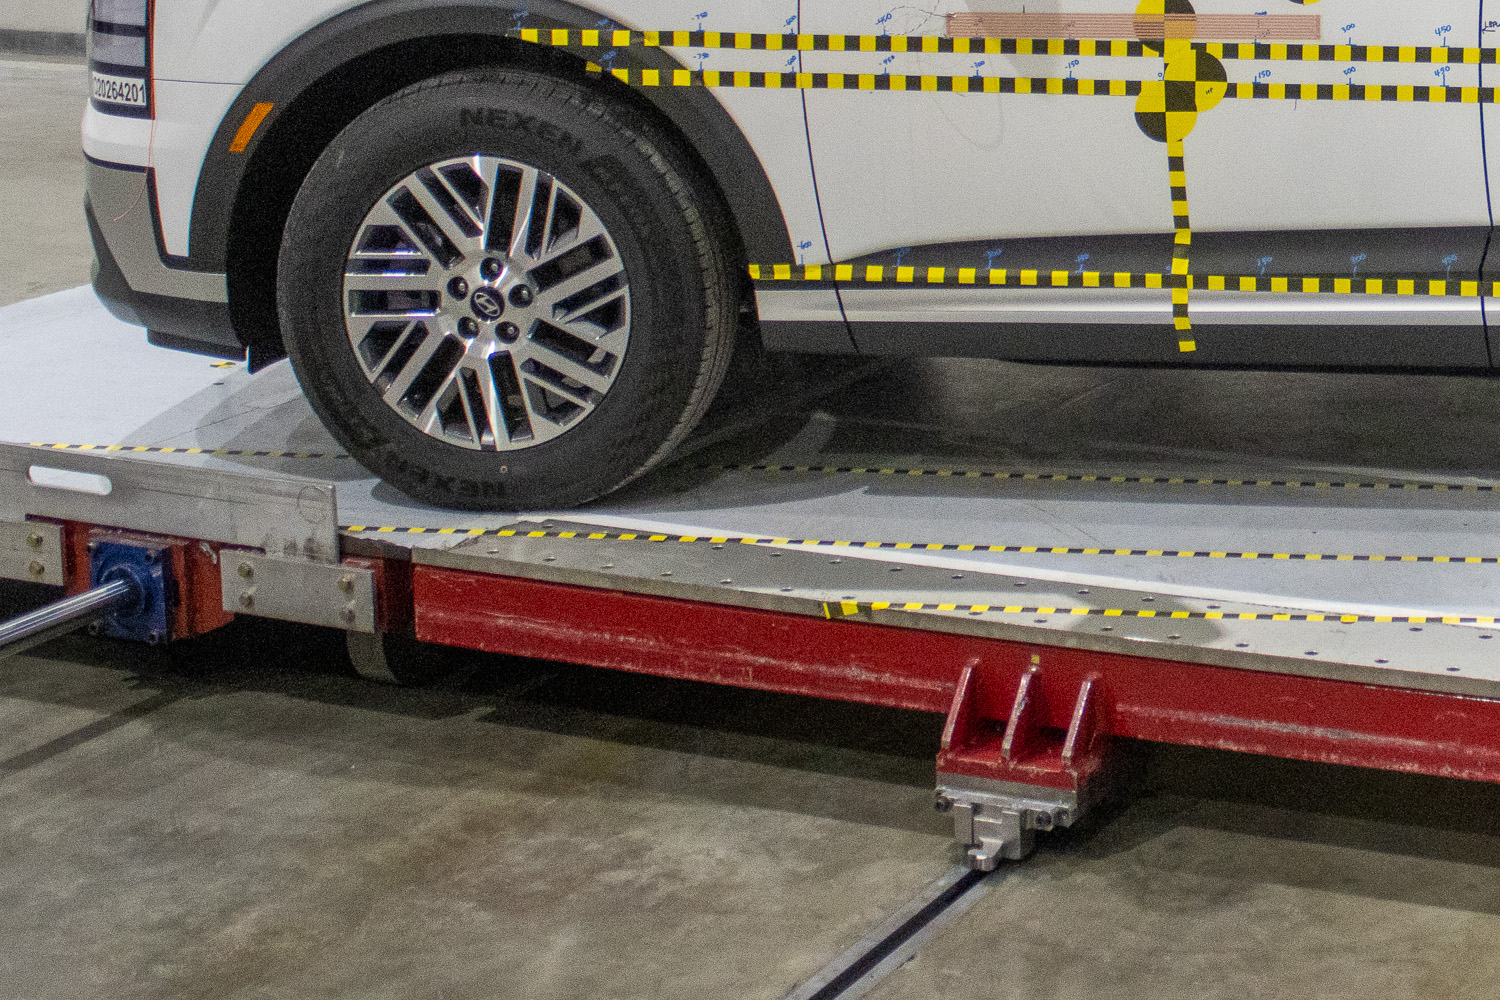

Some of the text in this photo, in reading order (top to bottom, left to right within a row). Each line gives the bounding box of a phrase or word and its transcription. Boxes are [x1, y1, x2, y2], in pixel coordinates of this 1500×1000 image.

[1434, 25, 1452, 36] 450
[1258, 70, 1271, 79] 150
[94, 77, 146, 103] 20264201
[460, 108, 584, 156] NEXEN
[386, 452, 505, 498] NEXEN
